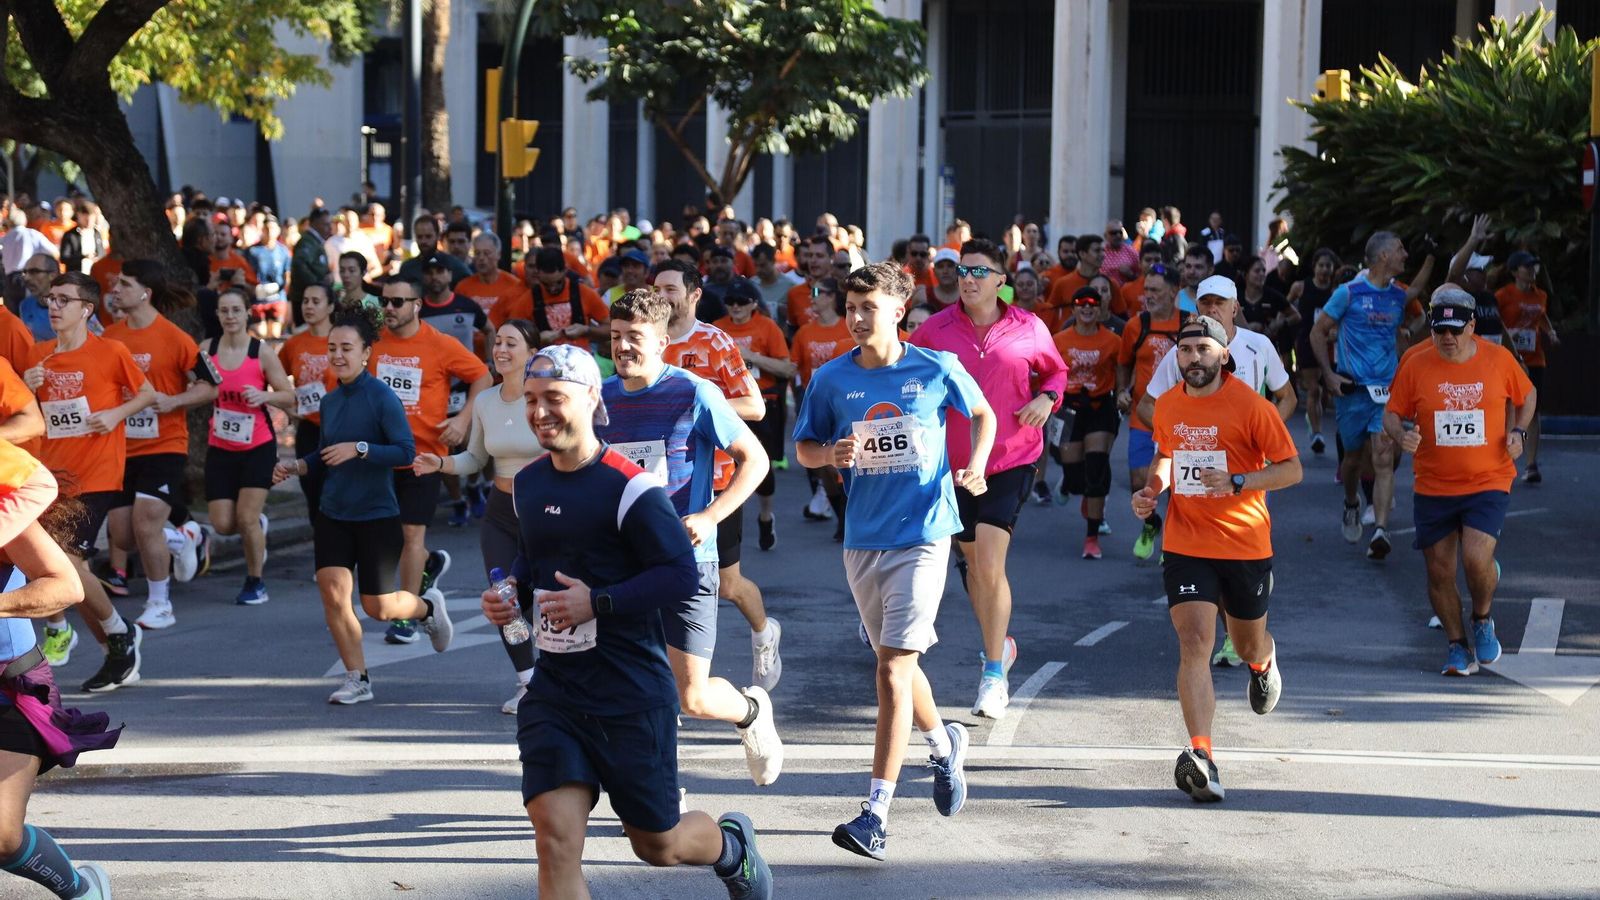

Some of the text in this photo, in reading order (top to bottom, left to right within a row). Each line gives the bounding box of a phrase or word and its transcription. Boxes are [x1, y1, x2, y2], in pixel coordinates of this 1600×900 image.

[846, 390, 866, 400] vive
[50, 411, 82, 427] 845
[222, 420, 241, 432] 93
[1442, 422, 1476, 435] 176
[863, 433, 908, 453] 466
[1180, 466, 1216, 480] 70
[545, 504, 561, 515] FILA
